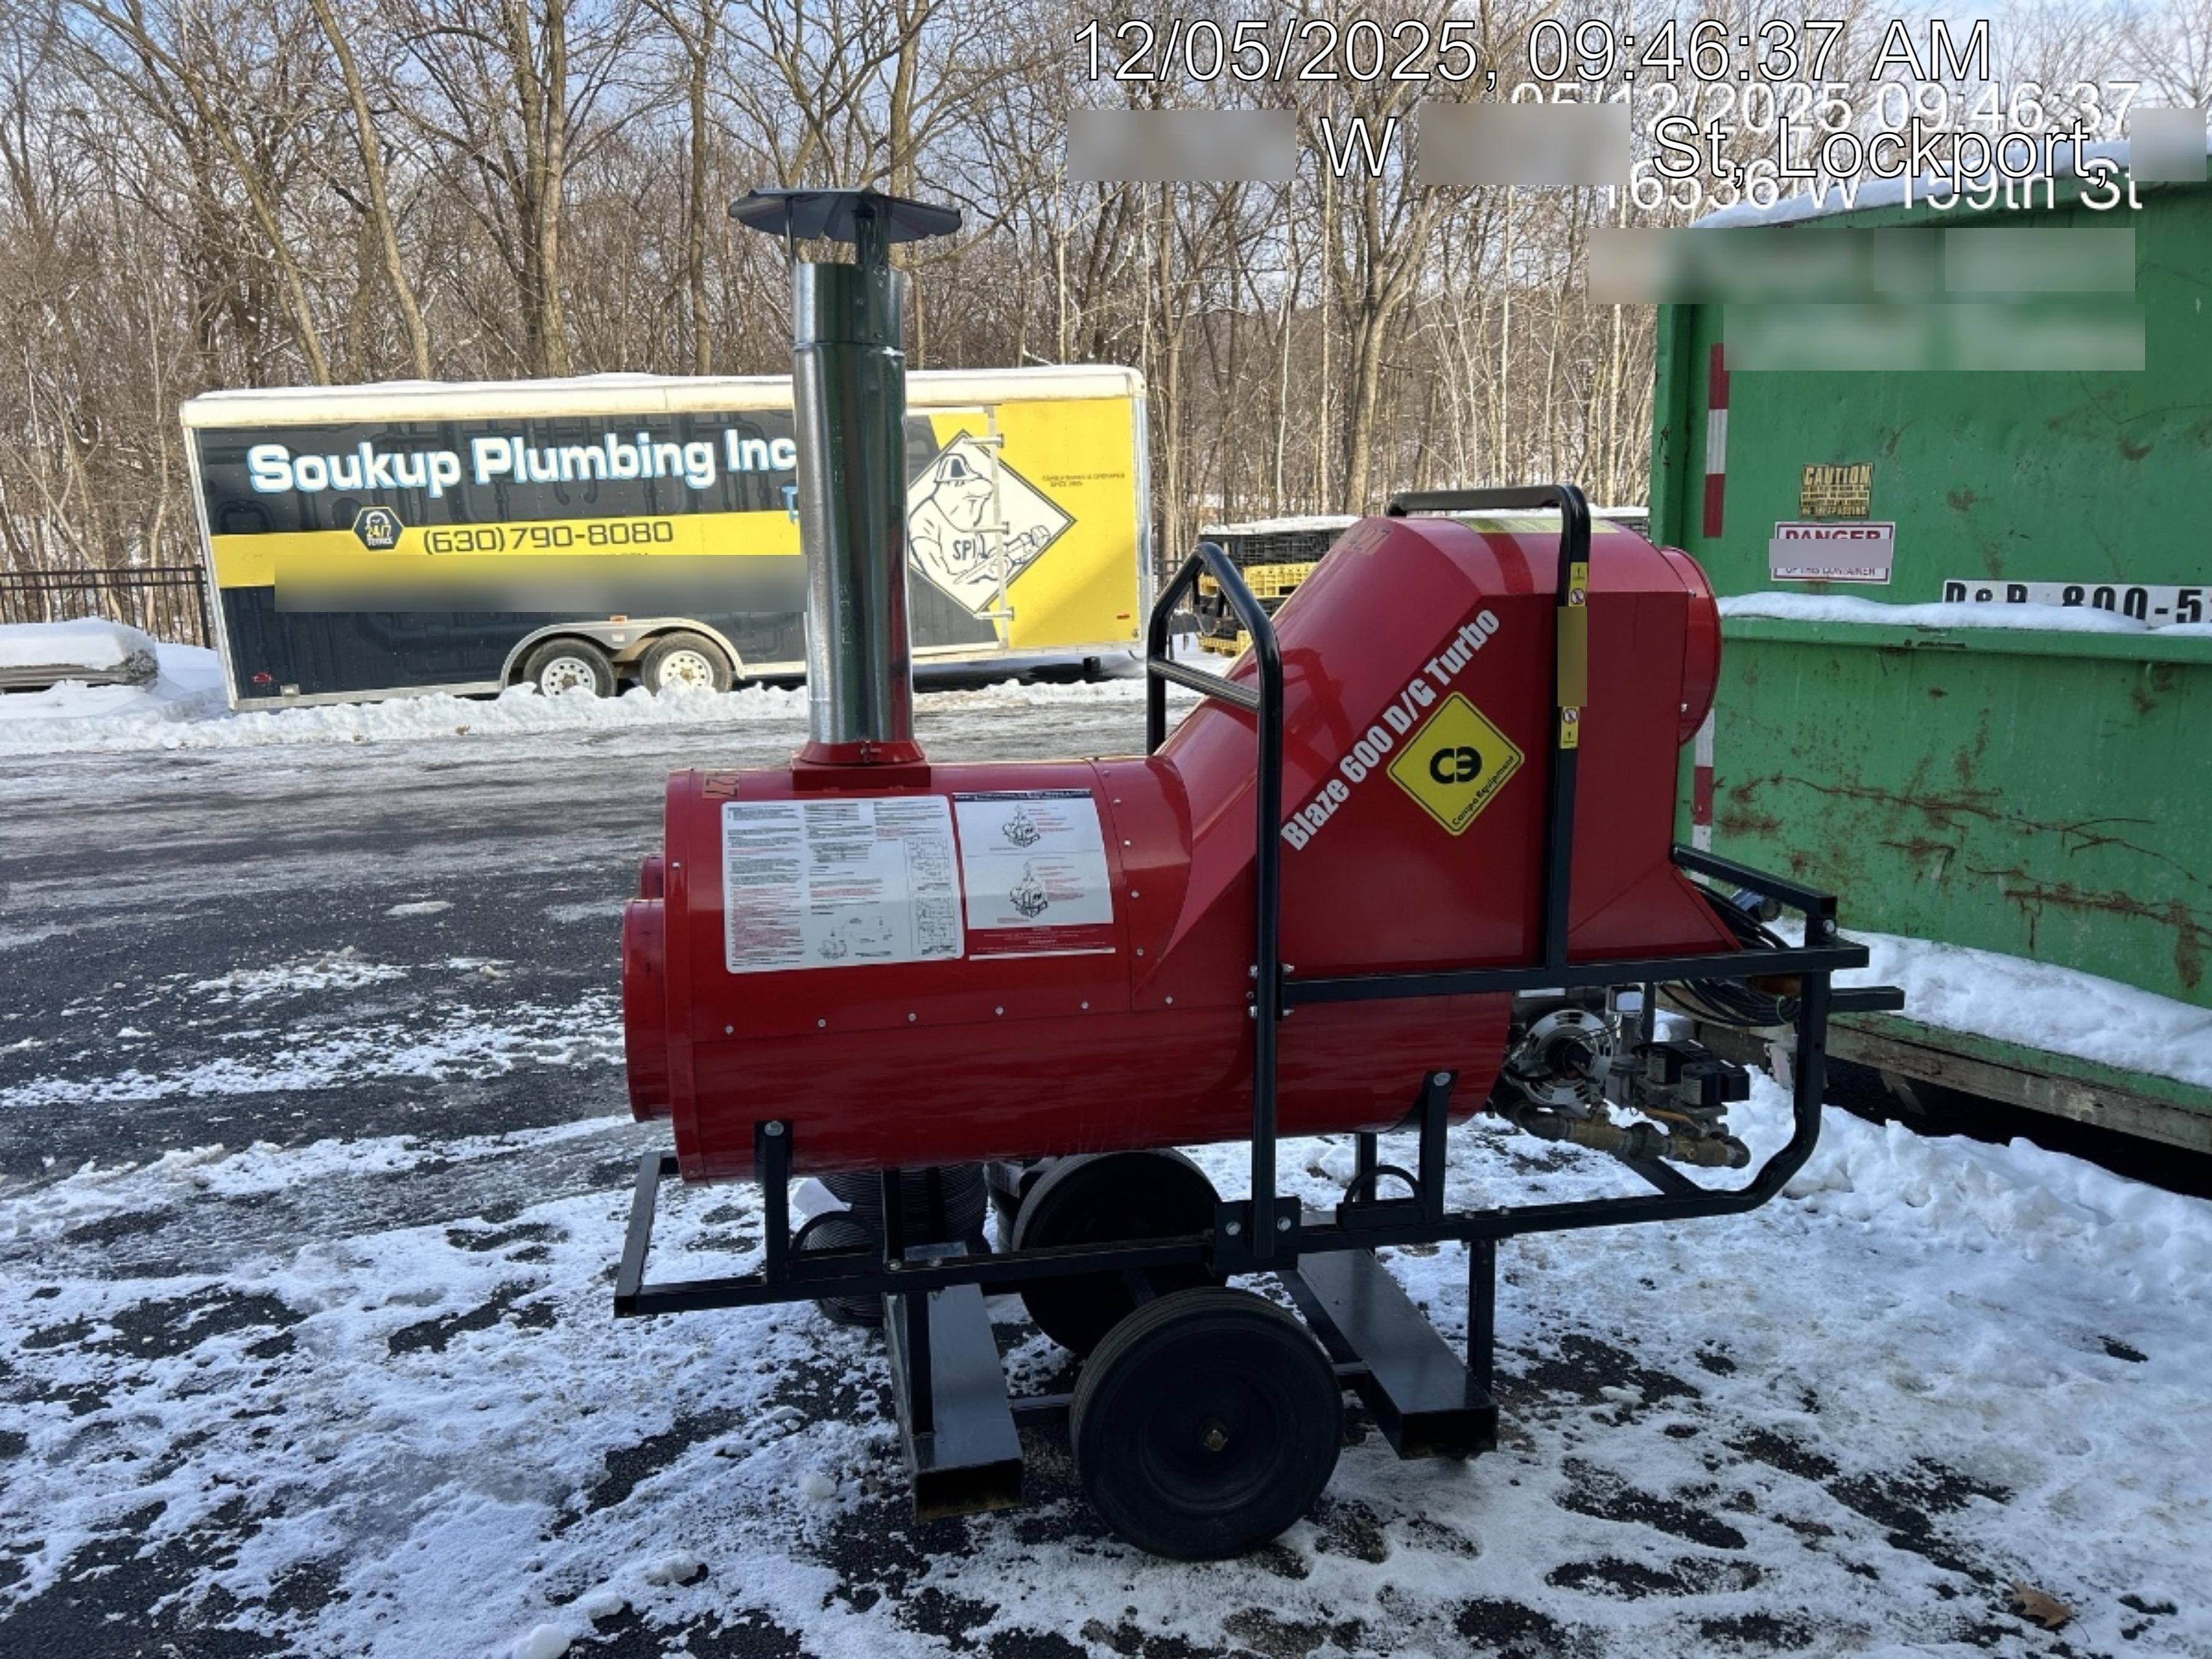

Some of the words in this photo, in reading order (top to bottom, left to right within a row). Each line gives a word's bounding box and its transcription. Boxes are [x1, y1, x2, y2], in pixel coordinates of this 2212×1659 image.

[247, 441, 461, 498] Soukup
[471, 432, 716, 489] Plumbing
[1804, 465, 1870, 485] CAUTION
[1281, 779, 1350, 851] Blaze
[1339, 725, 1394, 783] 600
[1382, 678, 1437, 736] D/G
[1423, 609, 1500, 686] Turbo
